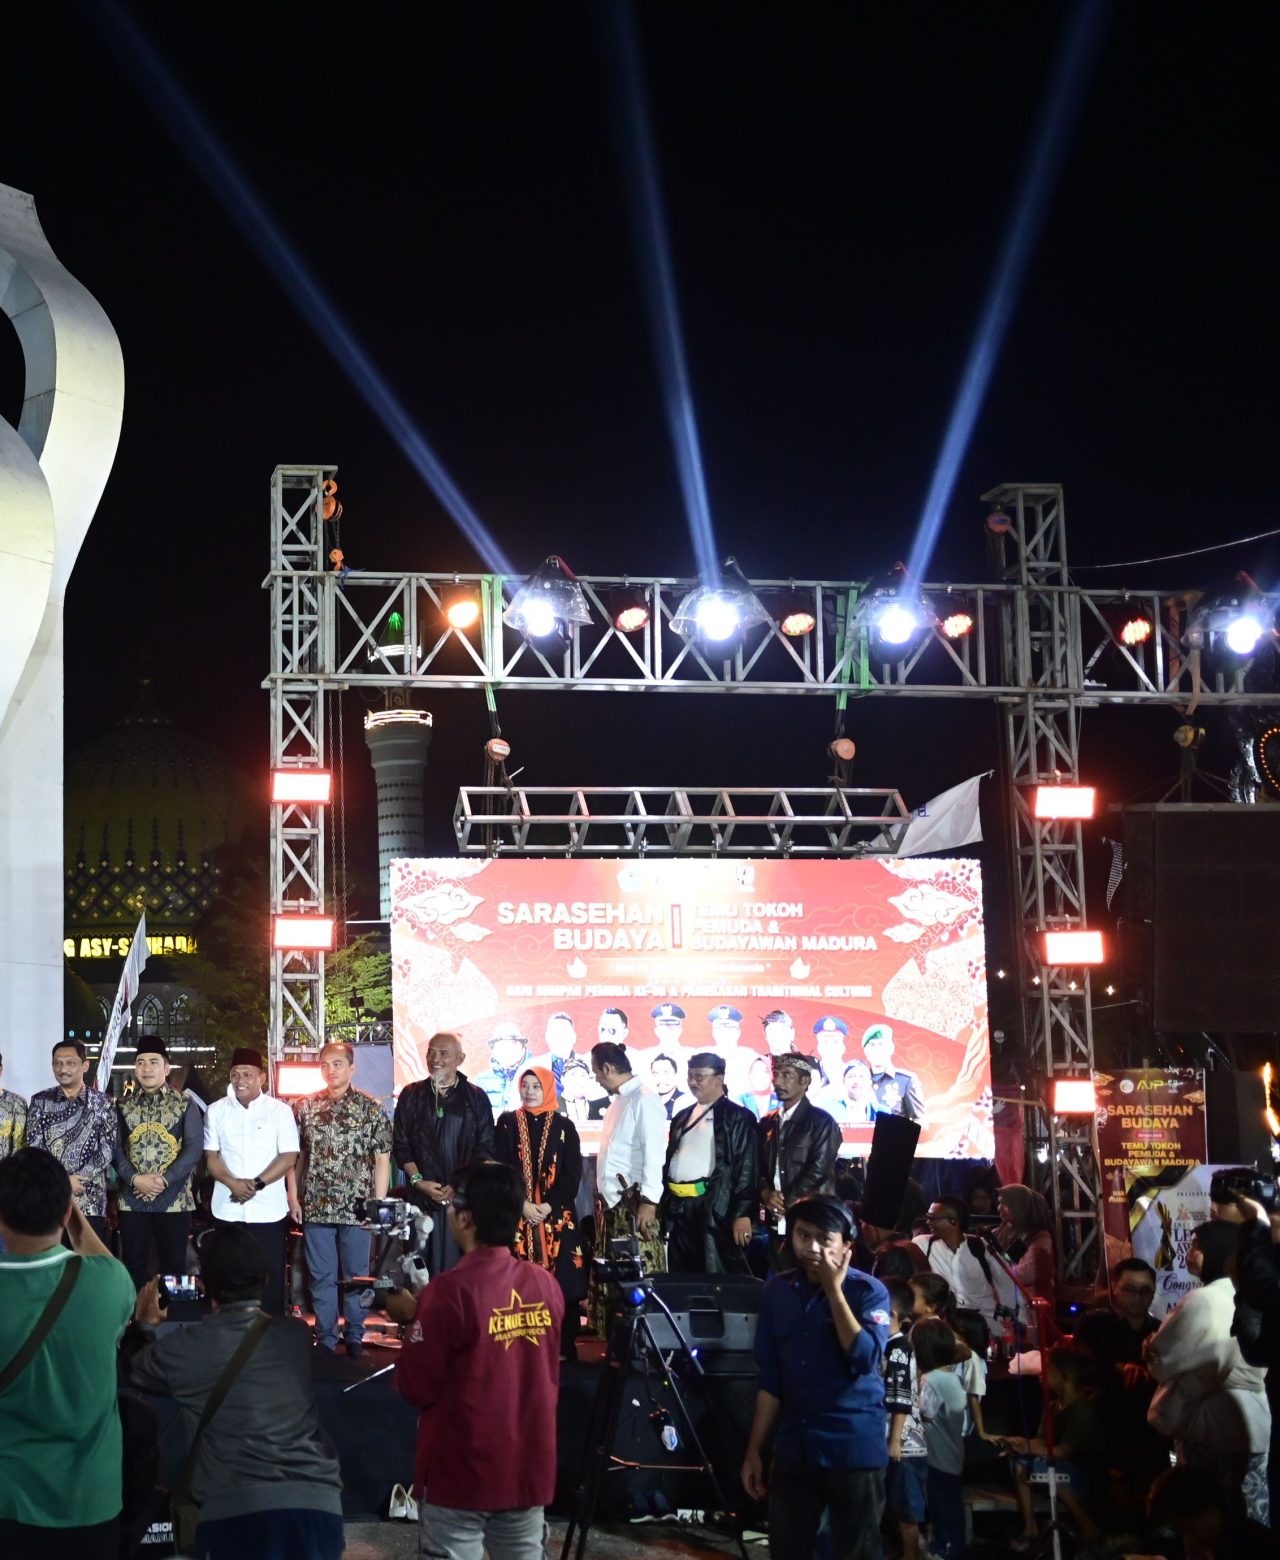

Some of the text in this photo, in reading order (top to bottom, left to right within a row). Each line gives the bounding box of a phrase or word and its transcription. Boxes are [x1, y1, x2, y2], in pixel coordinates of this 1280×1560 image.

[497, 901, 664, 925] SARASEHAN
[693, 902, 804, 918] TEMU TOKOH
[692, 919, 780, 935] PEMUDA &
[553, 928, 666, 951] BUDAYA
[692, 935, 878, 952] BUDAYAWAN MADURA
[1107, 1104, 1194, 1116] SARASEHAN
[1122, 1117, 1179, 1128] BUDAYA
[1121, 1142, 1181, 1150] TEMU TOKOH
[1128, 1150, 1166, 1158] PEMUDA
[1104, 1158, 1201, 1166] BUDAYAWAN MADURA
